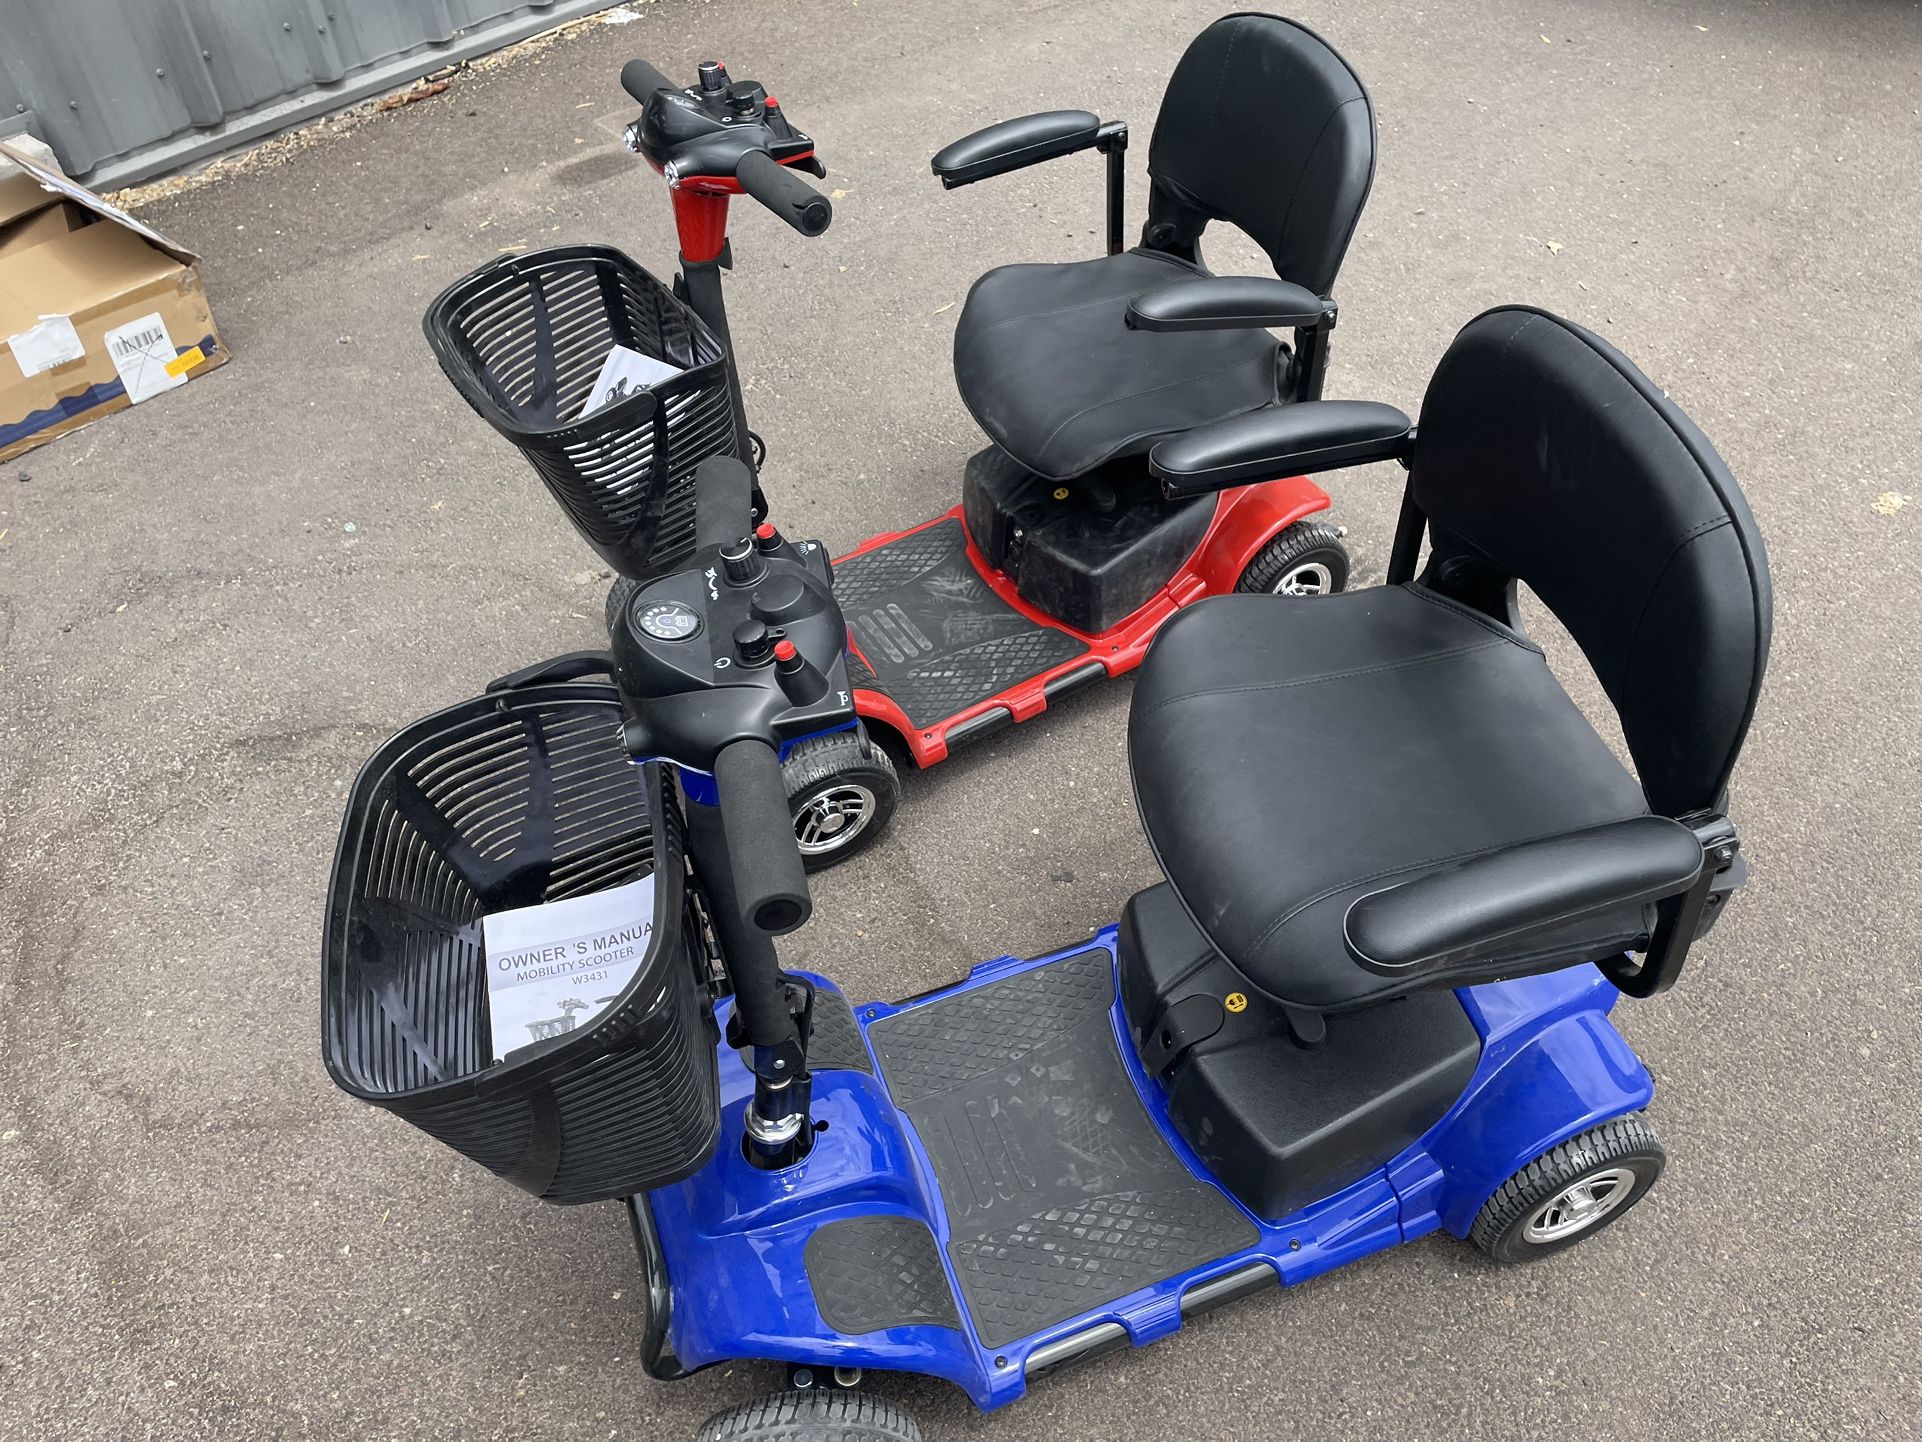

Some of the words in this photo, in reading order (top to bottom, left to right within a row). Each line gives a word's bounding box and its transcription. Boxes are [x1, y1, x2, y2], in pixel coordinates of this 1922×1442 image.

[498, 946, 566, 971] OWNER
[593, 922, 653, 951] MANUA
[517, 960, 575, 982] MOBILITY
[579, 946, 634, 969] SCOOTER
[572, 970, 609, 985] W3431
